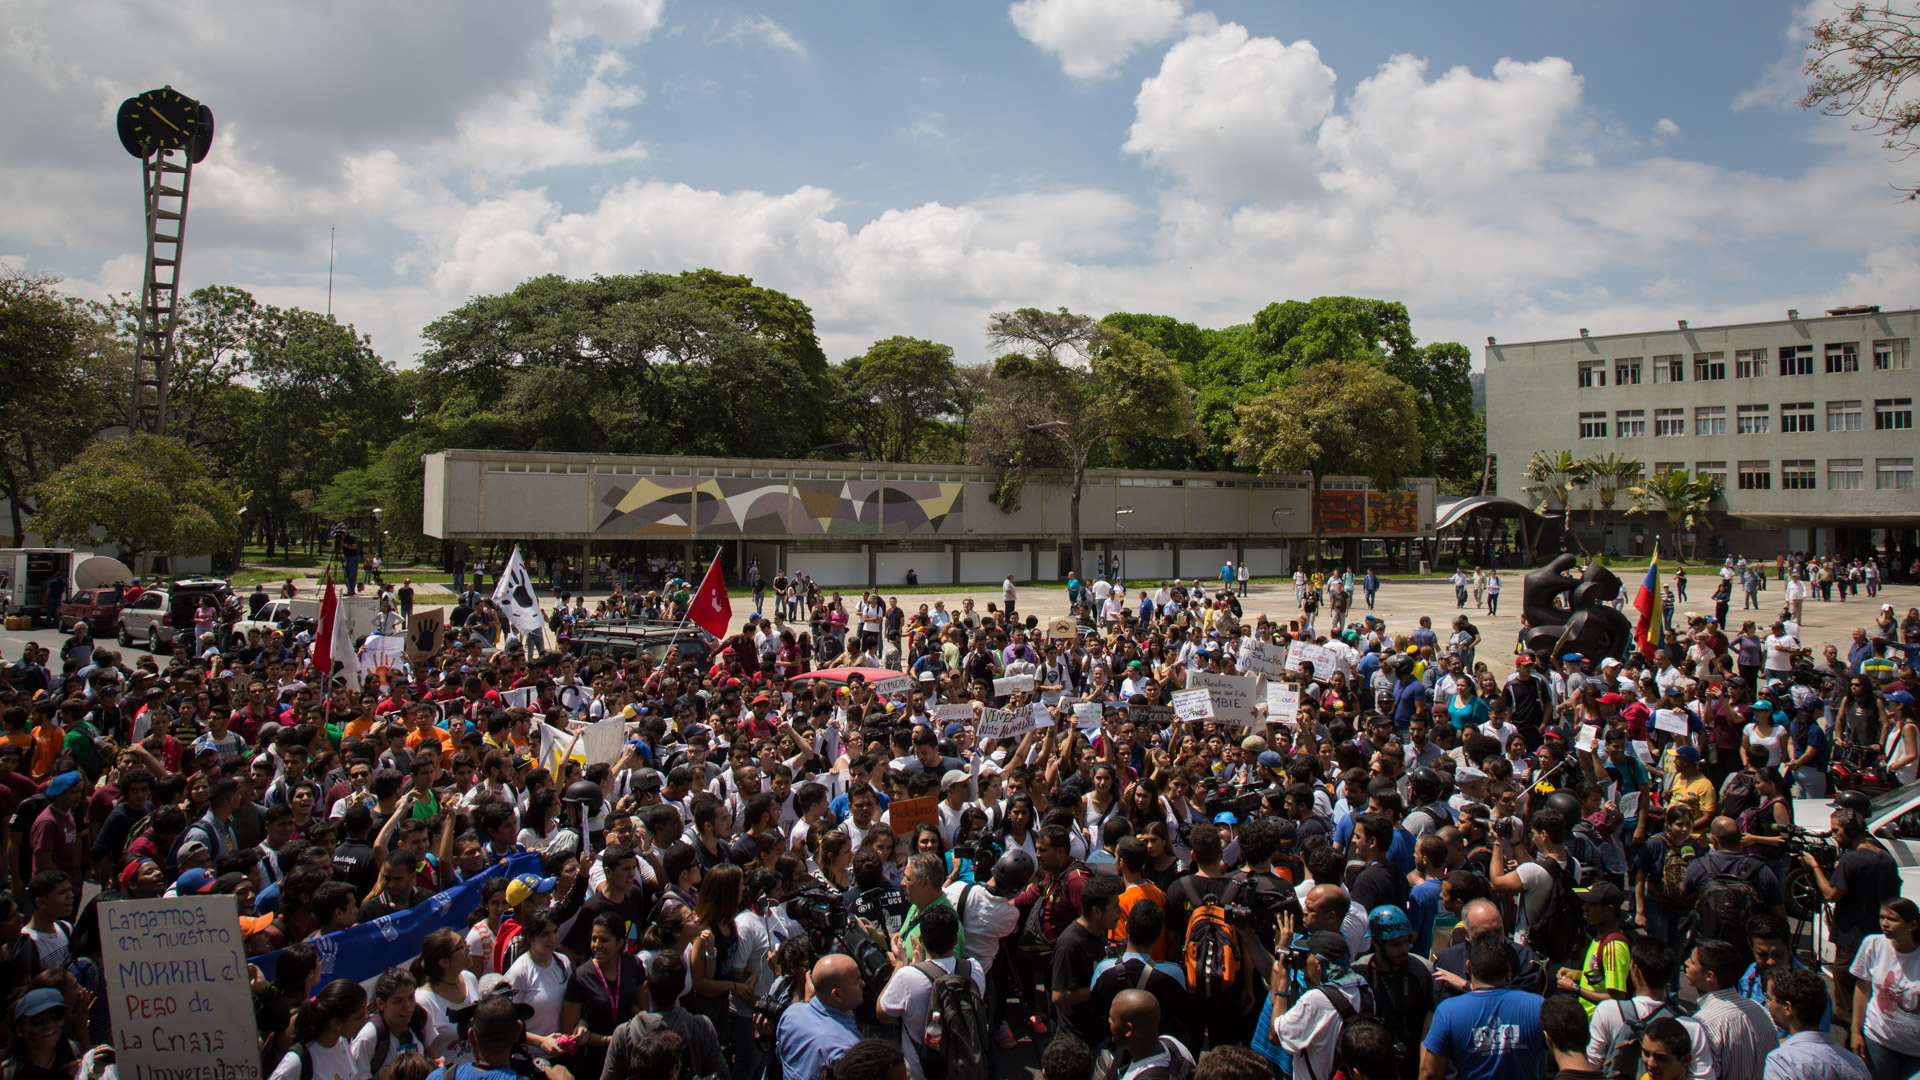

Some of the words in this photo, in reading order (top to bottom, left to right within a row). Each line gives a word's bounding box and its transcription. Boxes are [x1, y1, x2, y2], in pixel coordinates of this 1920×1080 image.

[1210, 698, 1242, 709] MBIE
[108, 907, 206, 937] Cargamos
[118, 936, 142, 951] en
[153, 927, 230, 949] nuestro
[118, 958, 216, 989] MORRAL
[221, 950, 241, 981] el
[125, 994, 177, 1020] PESO
[188, 991, 214, 1013] de
[120, 1029, 143, 1051] La
